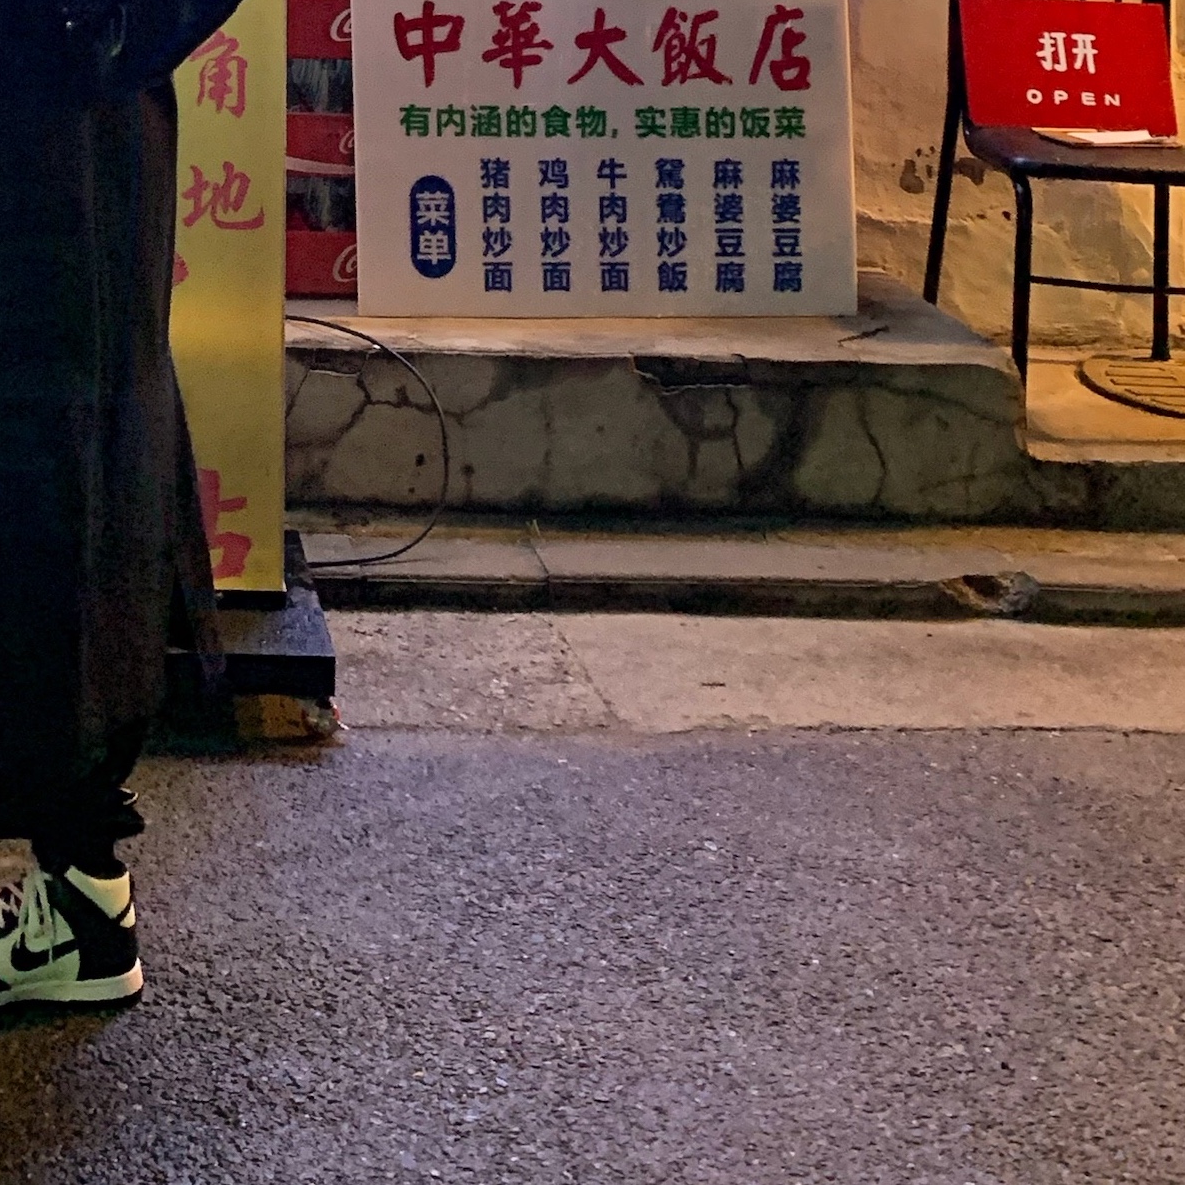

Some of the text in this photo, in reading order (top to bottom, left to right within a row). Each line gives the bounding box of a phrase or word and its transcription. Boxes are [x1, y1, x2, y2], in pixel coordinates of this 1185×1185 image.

[393, 0, 812, 92] 中華大飯店
[1026, 89, 1121, 106] OPEN
[1036, 31, 1098, 74] 打开
[415, 190, 452, 265] 菜单
[480, 157, 513, 292] 猪肉炒面
[538, 157, 571, 292] 鸡肉炒面
[597, 157, 629, 292] 牛肉炒面
[713, 158, 745, 292] 麻婆豆腐
[770, 158, 803, 292] 麻婆豆腐
